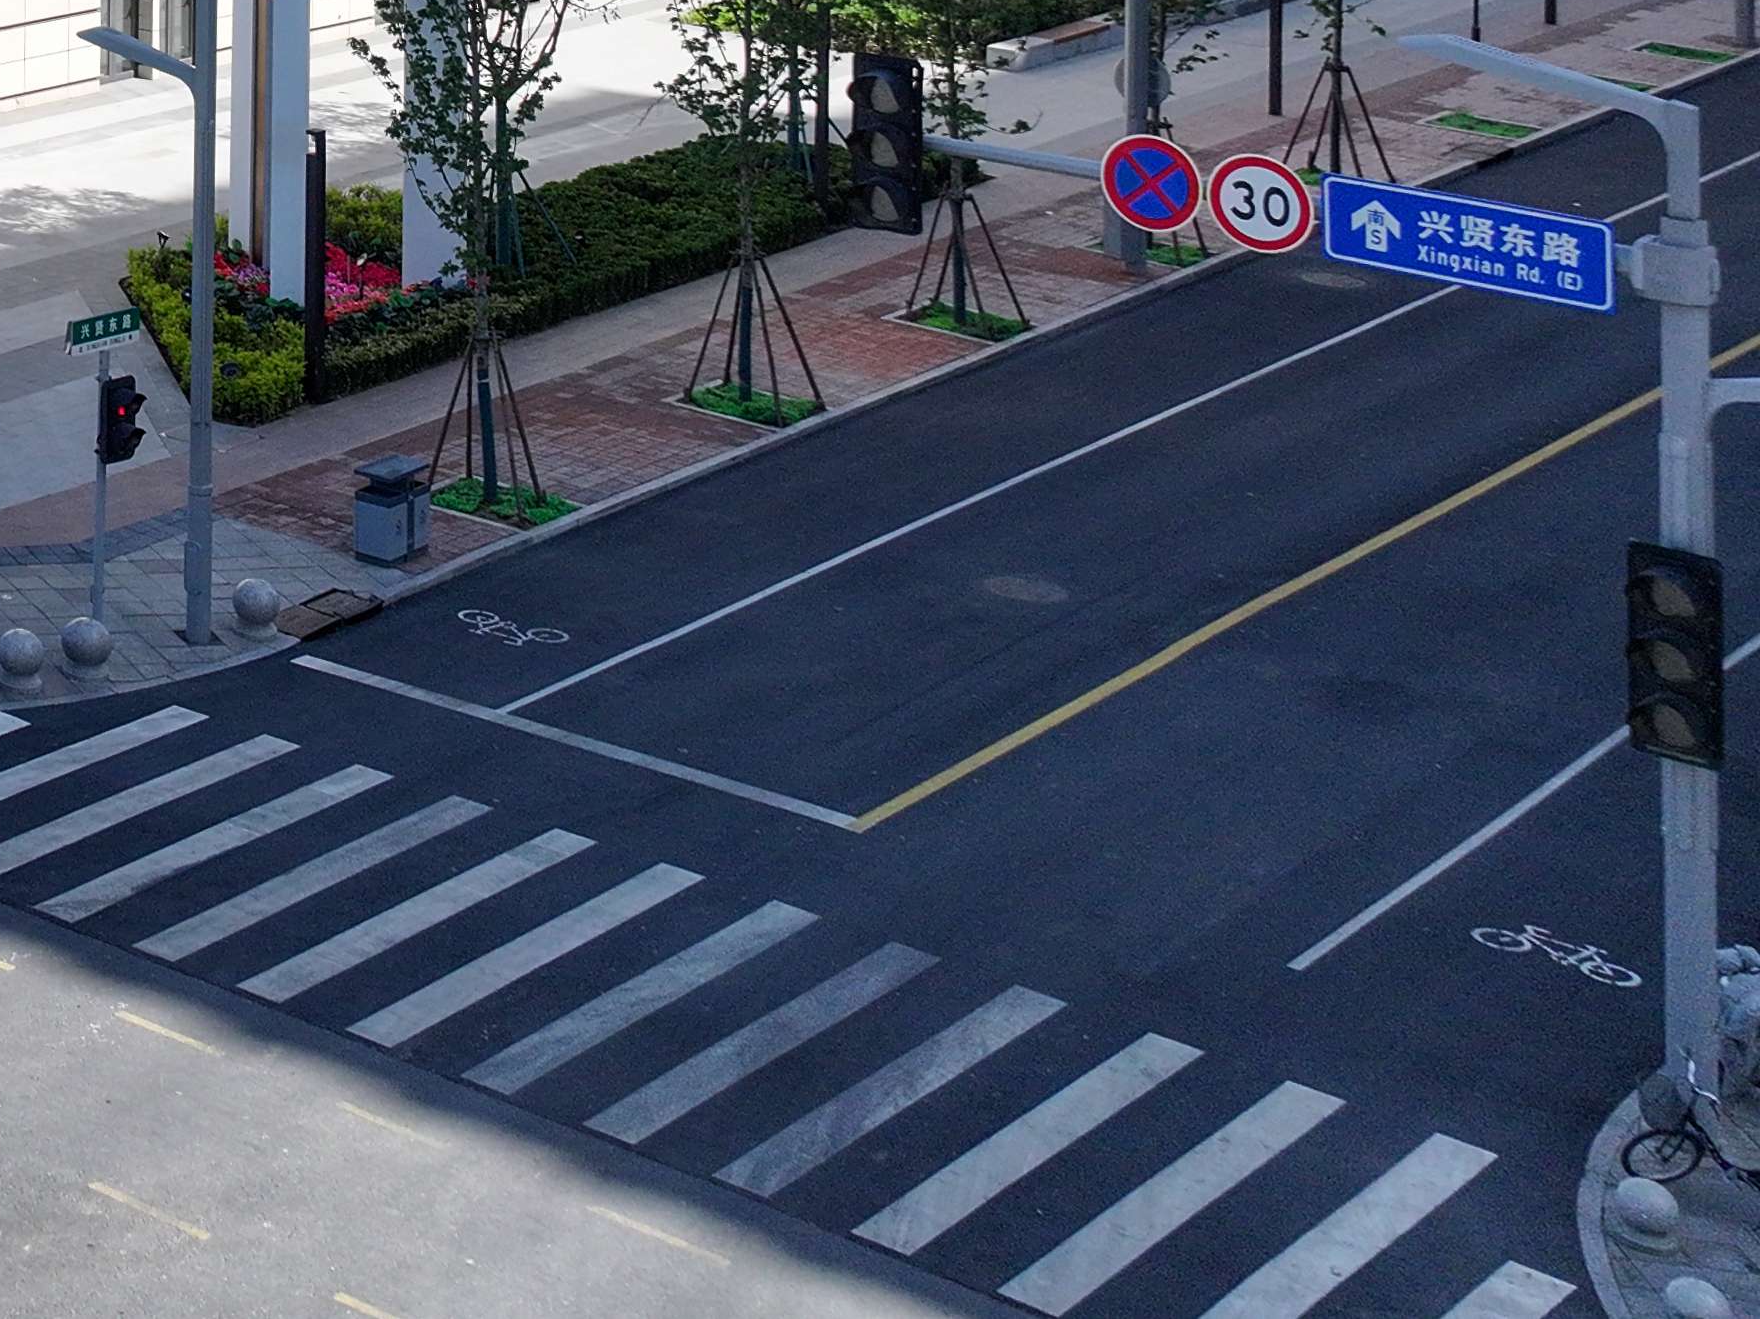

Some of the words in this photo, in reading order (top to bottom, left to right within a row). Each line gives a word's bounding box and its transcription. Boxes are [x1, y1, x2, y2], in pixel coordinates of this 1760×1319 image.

[1229, 179, 1291, 228] 30
[1369, 228, 1383, 247] S
[1417, 209, 1582, 268] 兴贤东路
[1417, 244, 1507, 279] Xingxian
[1516, 261, 1547, 287] Rd.
[1555, 268, 1584, 293] (E)
[80, 313, 132, 340] 兴贤东路
